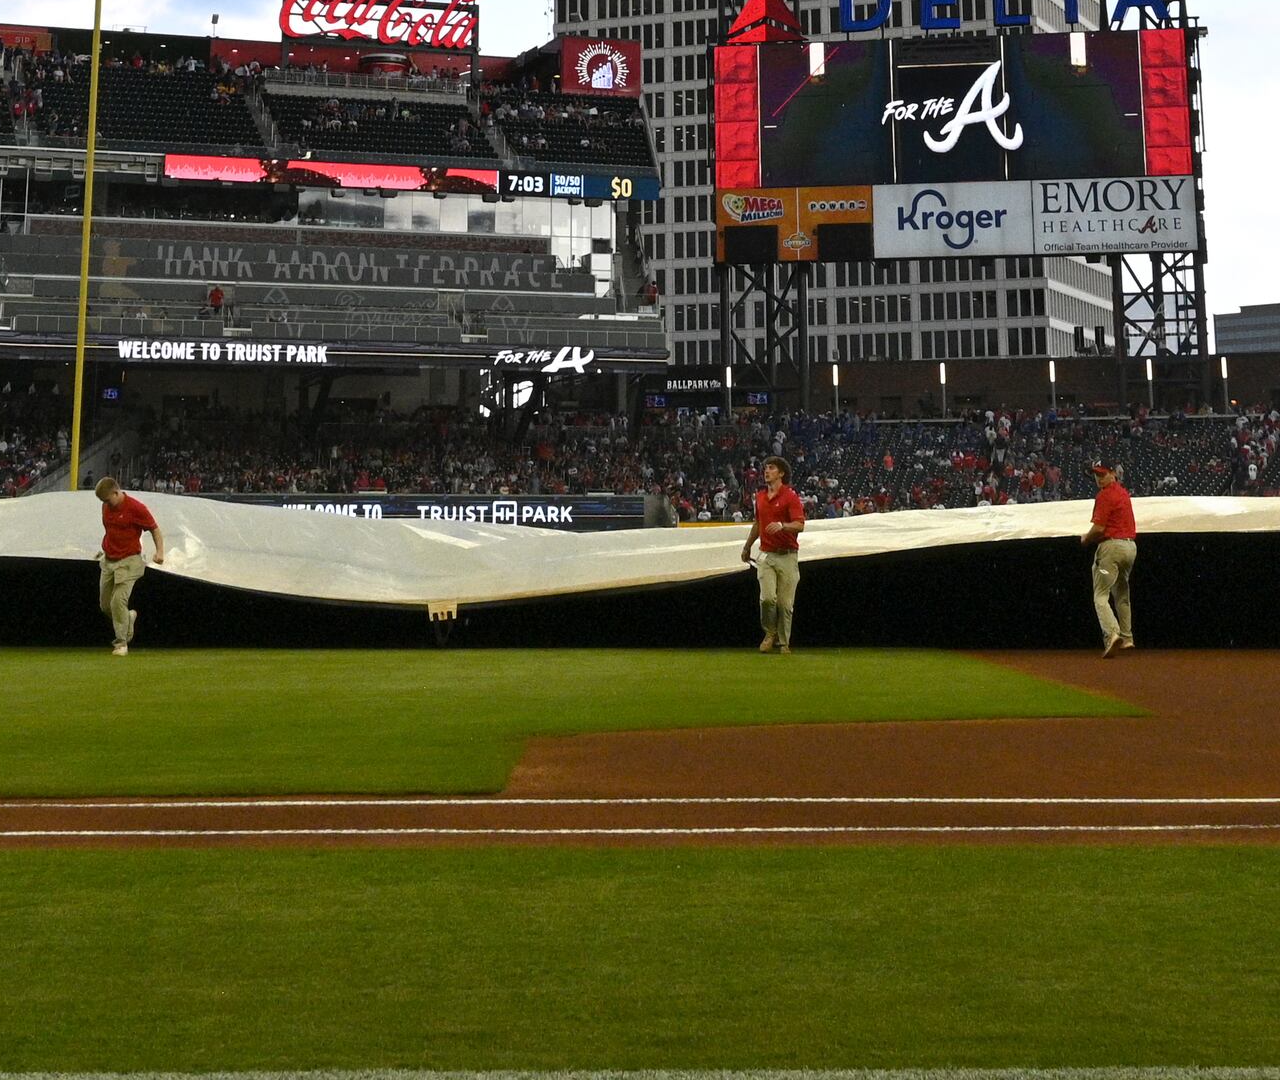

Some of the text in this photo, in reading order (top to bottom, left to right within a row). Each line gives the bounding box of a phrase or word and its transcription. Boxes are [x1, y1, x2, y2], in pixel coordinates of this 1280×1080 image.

[882, 60, 1024, 153] FOR THE A
[508, 175, 544, 193] 7:03
[554, 174, 580, 187] 50/50
[611, 176, 633, 199] $0
[554, 185, 581, 196] JACKPOT
[1041, 178, 1187, 214] EMORY
[744, 196, 783, 212] MEGA
[741, 210, 783, 223] MILLIONS
[898, 189, 1007, 250] Kroger
[1043, 215, 1182, 234] HEALTHCARE
[1044, 240, 1188, 252] Official Team Healthcare Provider
[157, 244, 253, 278] HANK
[267, 248, 391, 283] AARON
[118, 340, 329, 364] WELCOME TO TRUIST PARK
[494, 349, 522, 366] FOR
[525, 348, 552, 364] THE
[667, 379, 709, 390] BALLPARK
[417, 505, 489, 521] TRUIST
[522, 505, 573, 523] PARK
